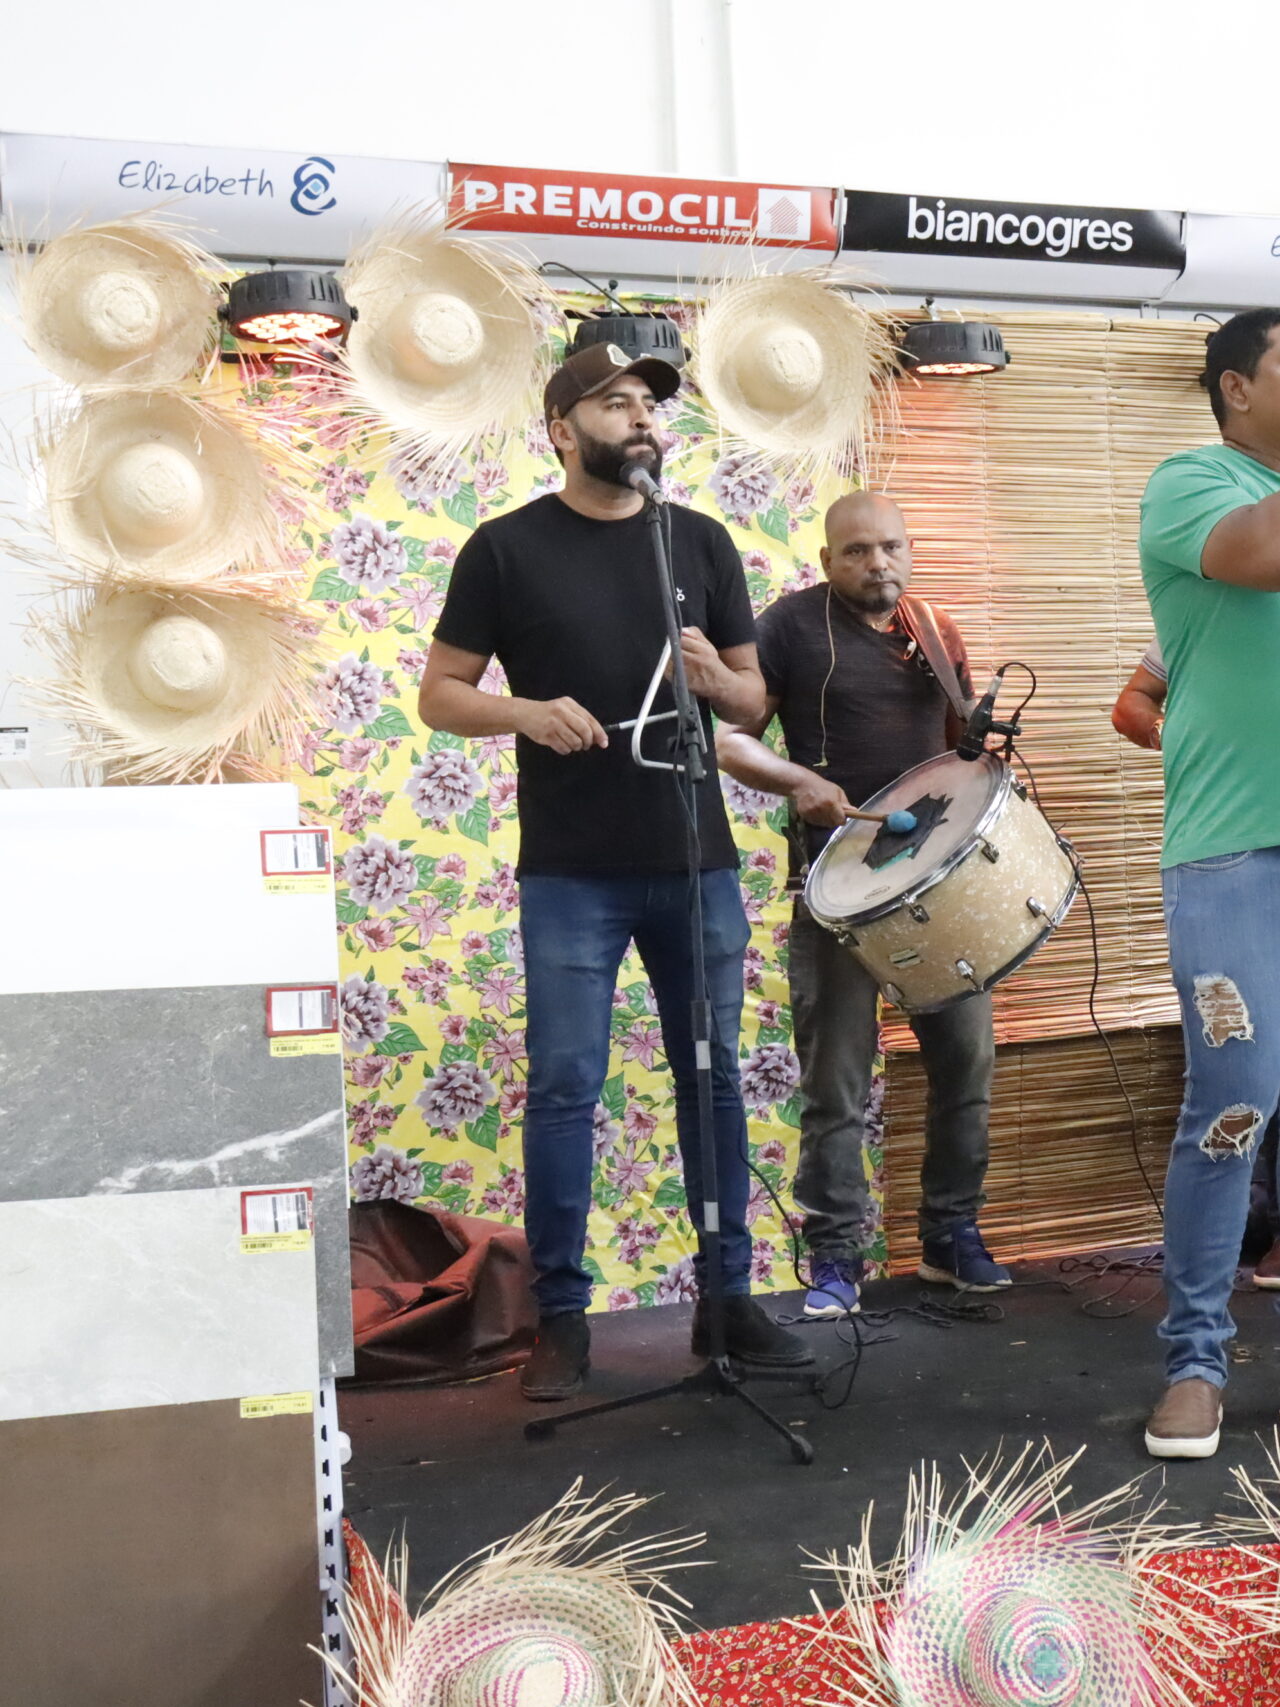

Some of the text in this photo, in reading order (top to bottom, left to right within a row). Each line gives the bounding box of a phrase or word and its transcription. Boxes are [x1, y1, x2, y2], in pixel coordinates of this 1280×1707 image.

[118, 160, 274, 198] Elizabeth
[464, 180, 752, 228] PREMOCIL
[576, 218, 685, 234] Construindo
[907, 197, 1133, 257] biancogres
